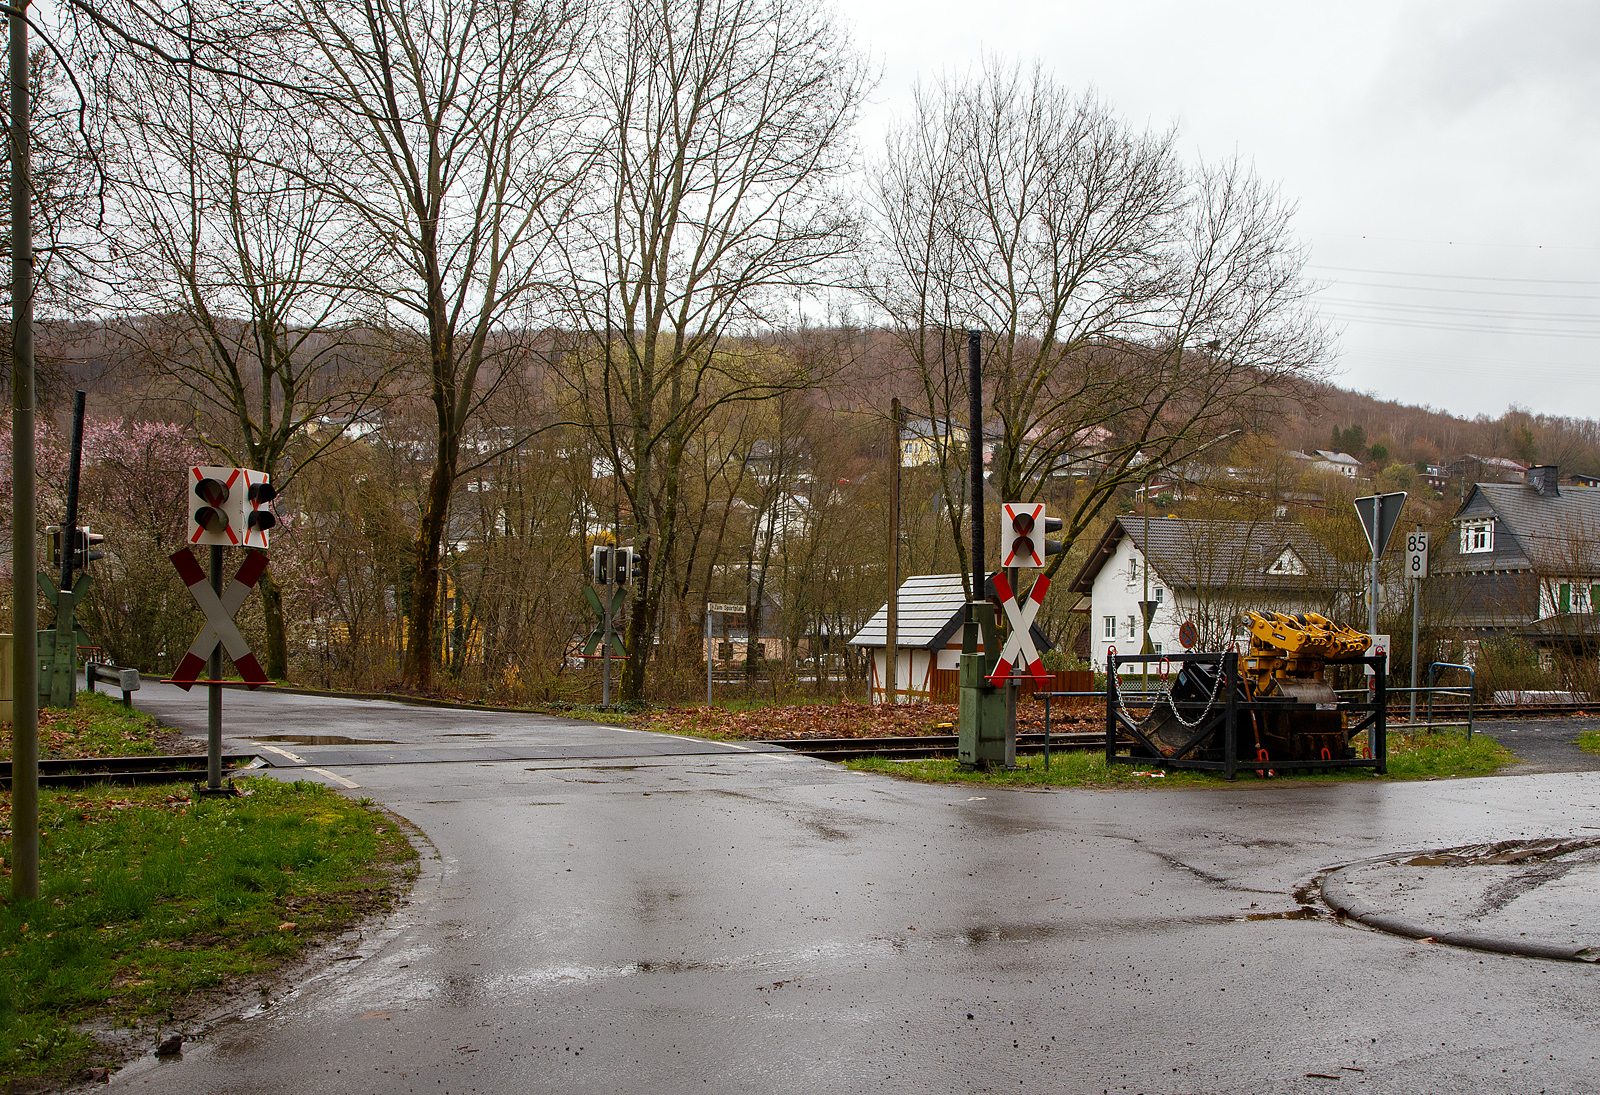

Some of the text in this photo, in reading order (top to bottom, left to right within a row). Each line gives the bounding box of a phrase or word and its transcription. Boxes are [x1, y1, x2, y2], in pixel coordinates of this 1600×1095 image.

[1408, 536, 1427, 552] 85
[1411, 555, 1421, 571] 8
[724, 604, 745, 612] Sportplatz
